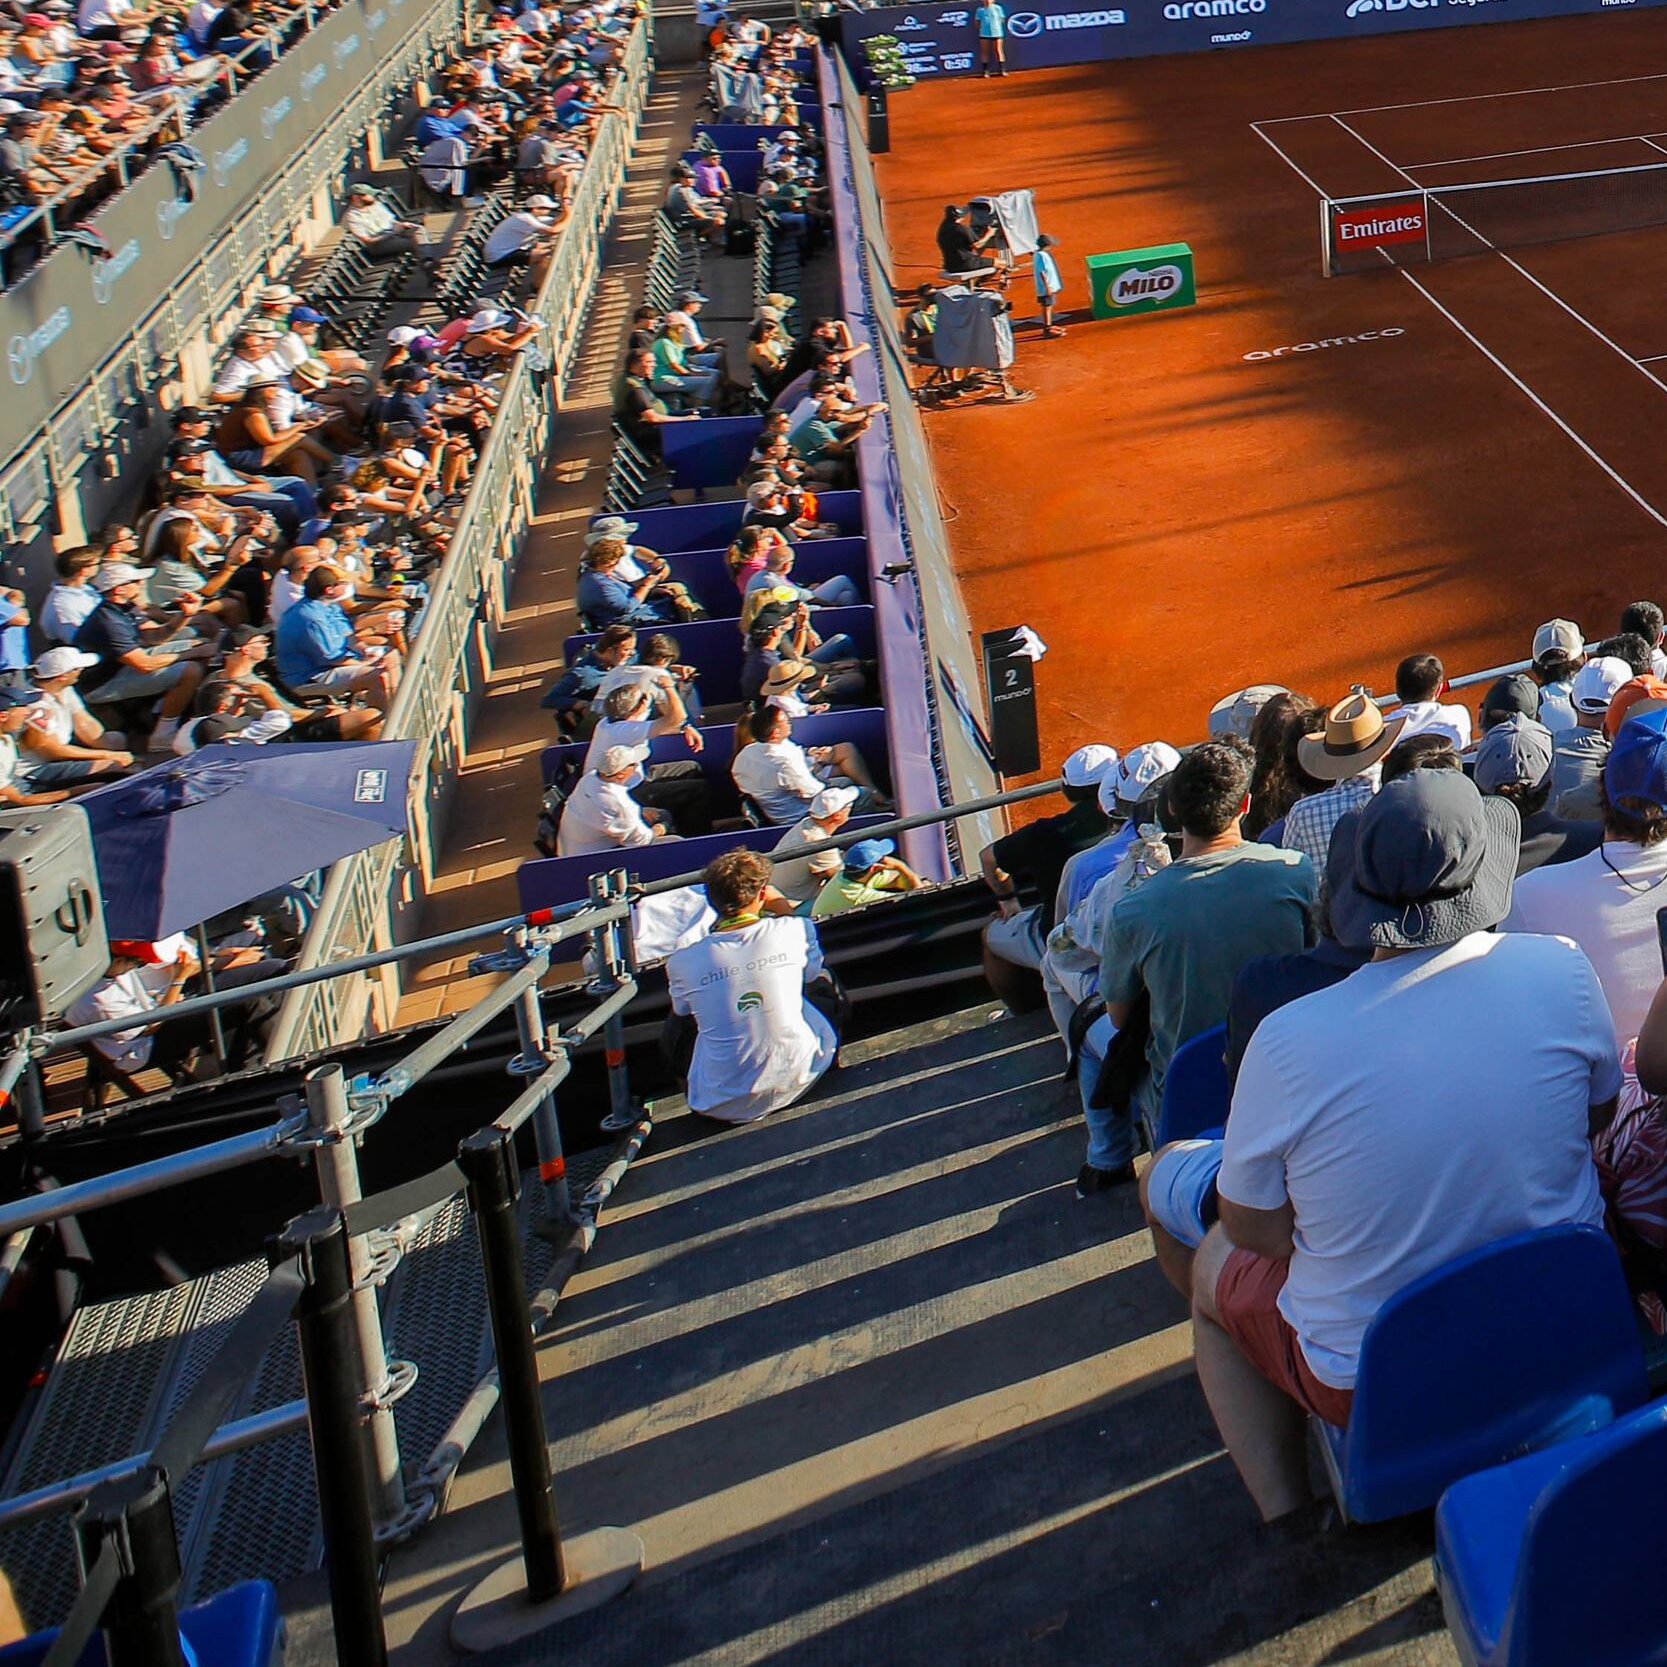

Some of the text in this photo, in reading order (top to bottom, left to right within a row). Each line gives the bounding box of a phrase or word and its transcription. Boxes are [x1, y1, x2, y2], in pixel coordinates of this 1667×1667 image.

[1045, 9, 1127, 29] mazda
[1340, 215, 1422, 240] Emirates
[1118, 276, 1173, 298] MILO
[1242, 328, 1406, 362] aramco
[1004, 670, 1015, 686] 2
[700, 951, 788, 996] chile open
